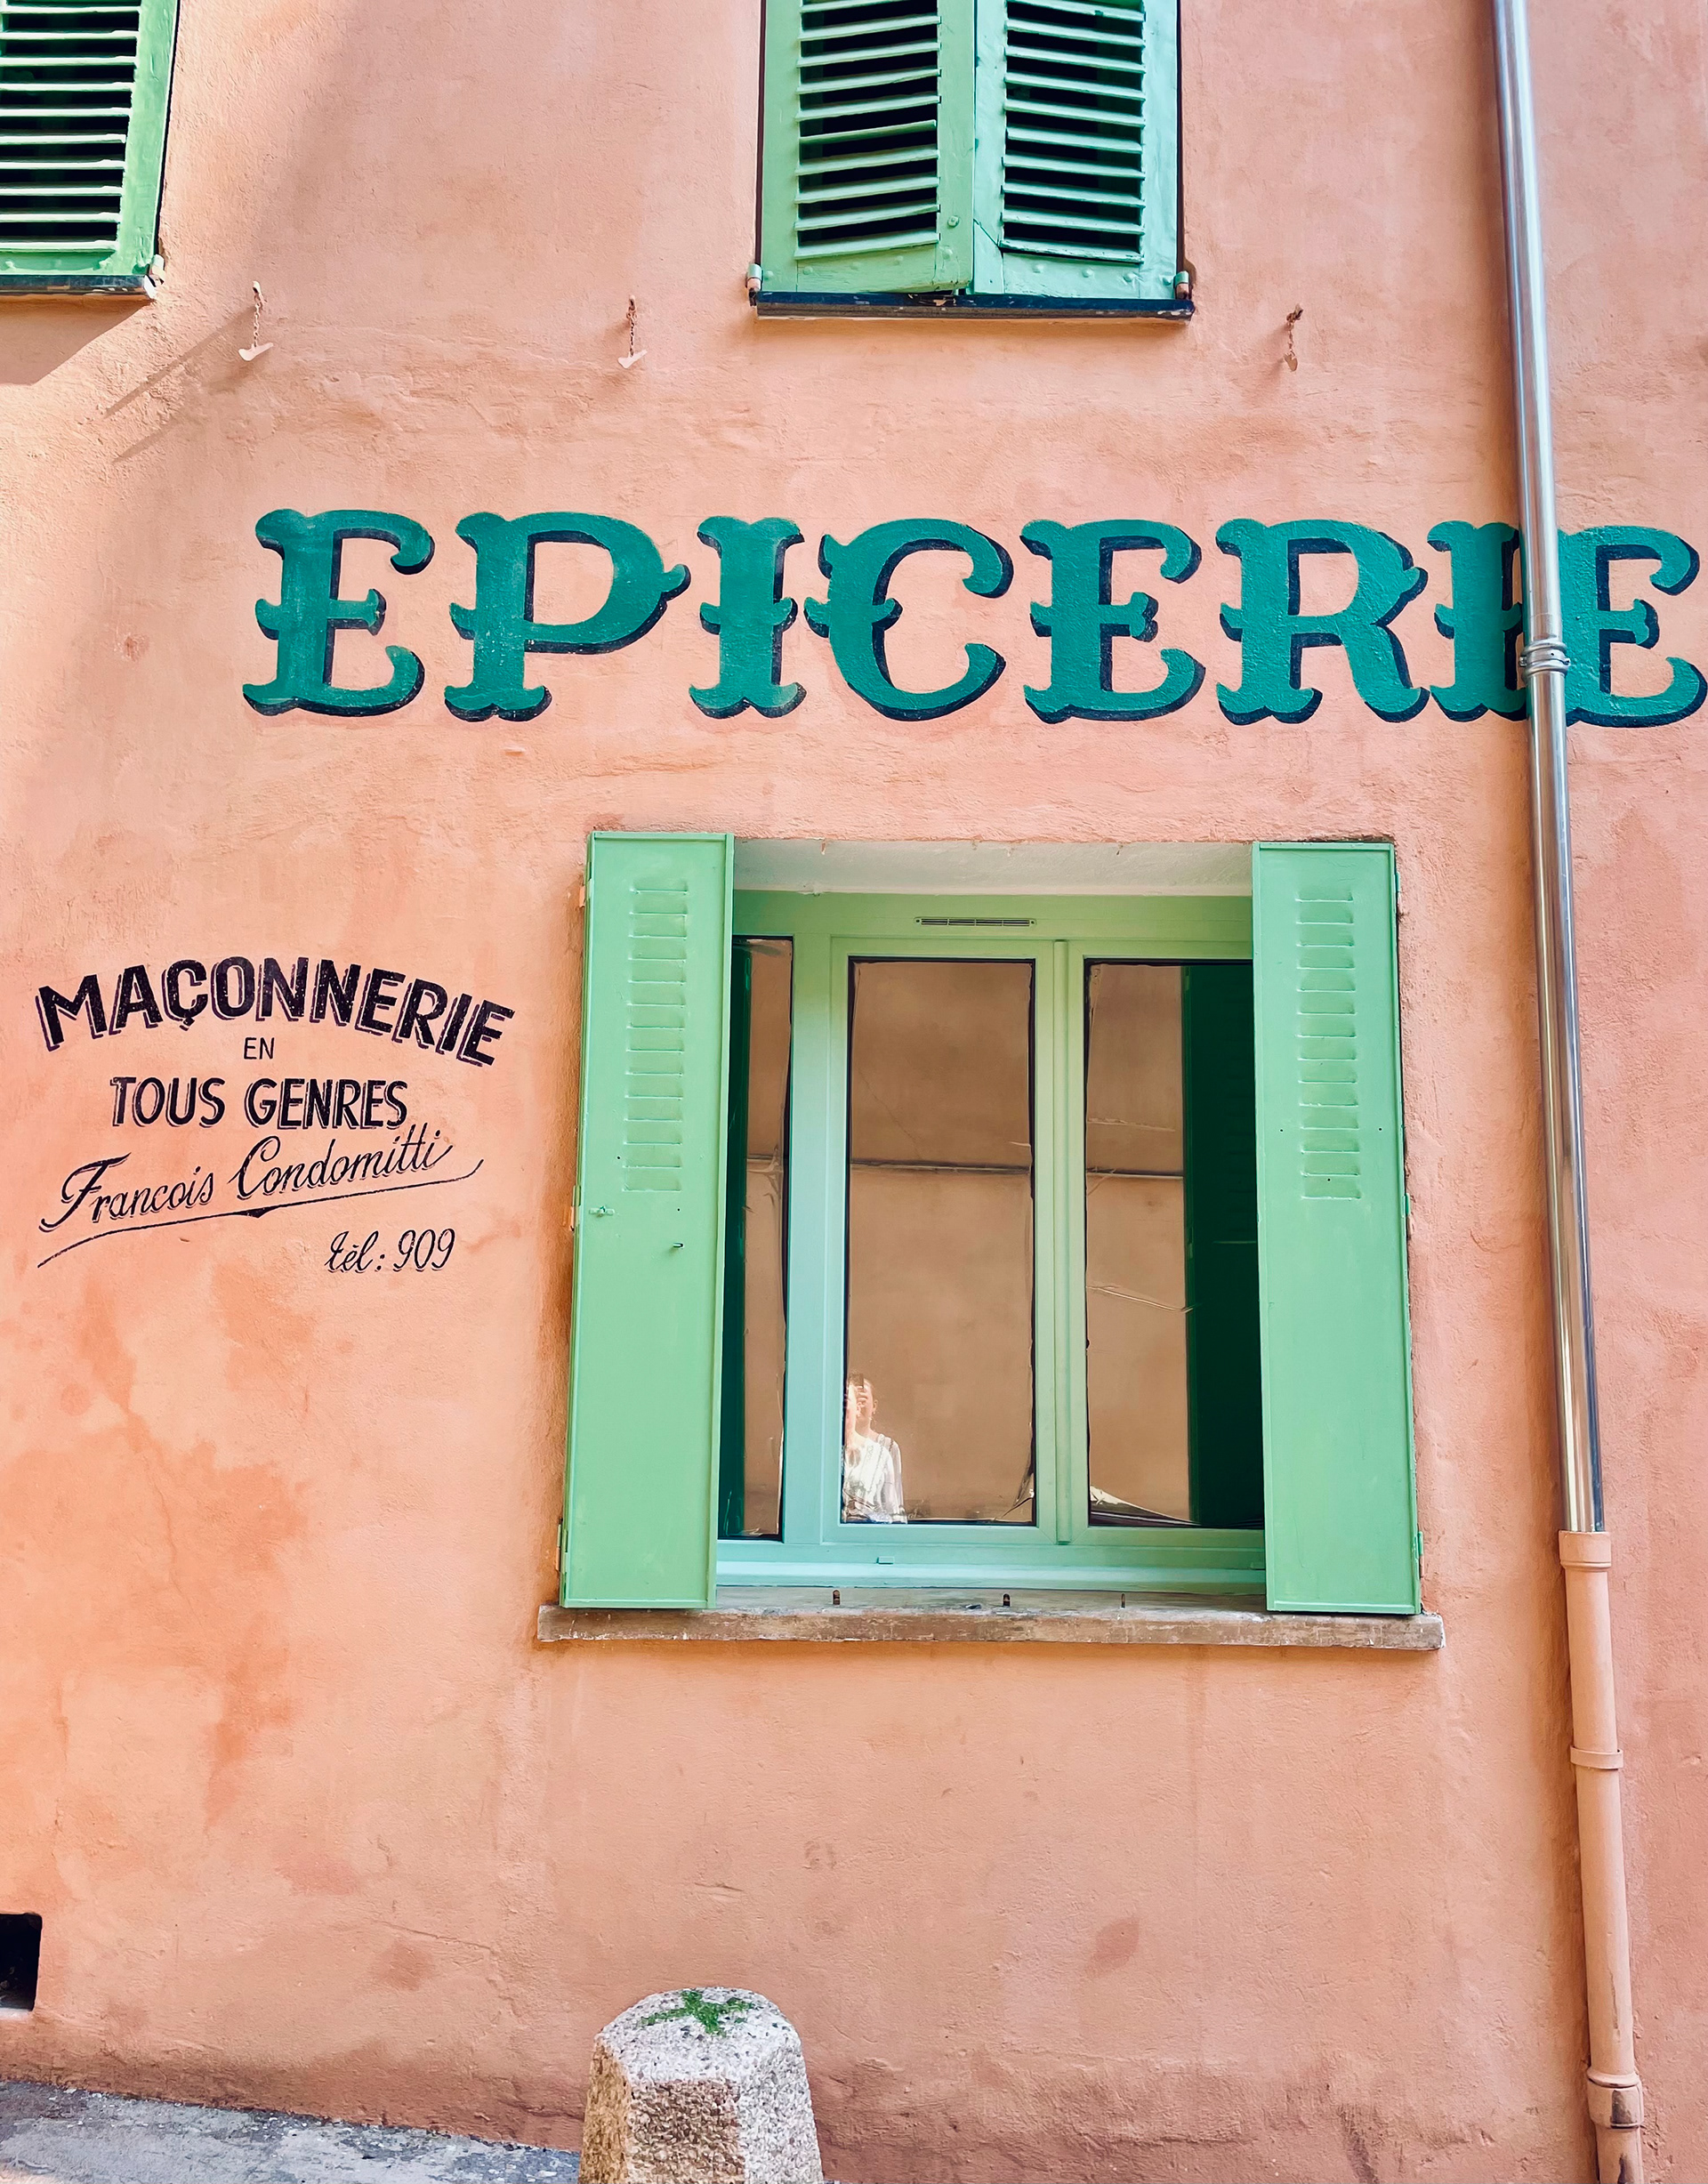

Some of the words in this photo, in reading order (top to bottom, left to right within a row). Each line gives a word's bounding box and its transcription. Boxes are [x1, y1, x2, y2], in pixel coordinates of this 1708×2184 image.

[243, 508, 1707, 728] EPICERIE
[35, 956, 515, 1067] MAÇONNERIE
[243, 1037, 275, 1060] EN
[109, 1076, 226, 1128] TOUS
[243, 1077, 408, 1129] GENRES
[38, 1151, 214, 1233] Francois
[226, 1122, 453, 1200] Condomitti
[392, 1228, 455, 1271] 909
